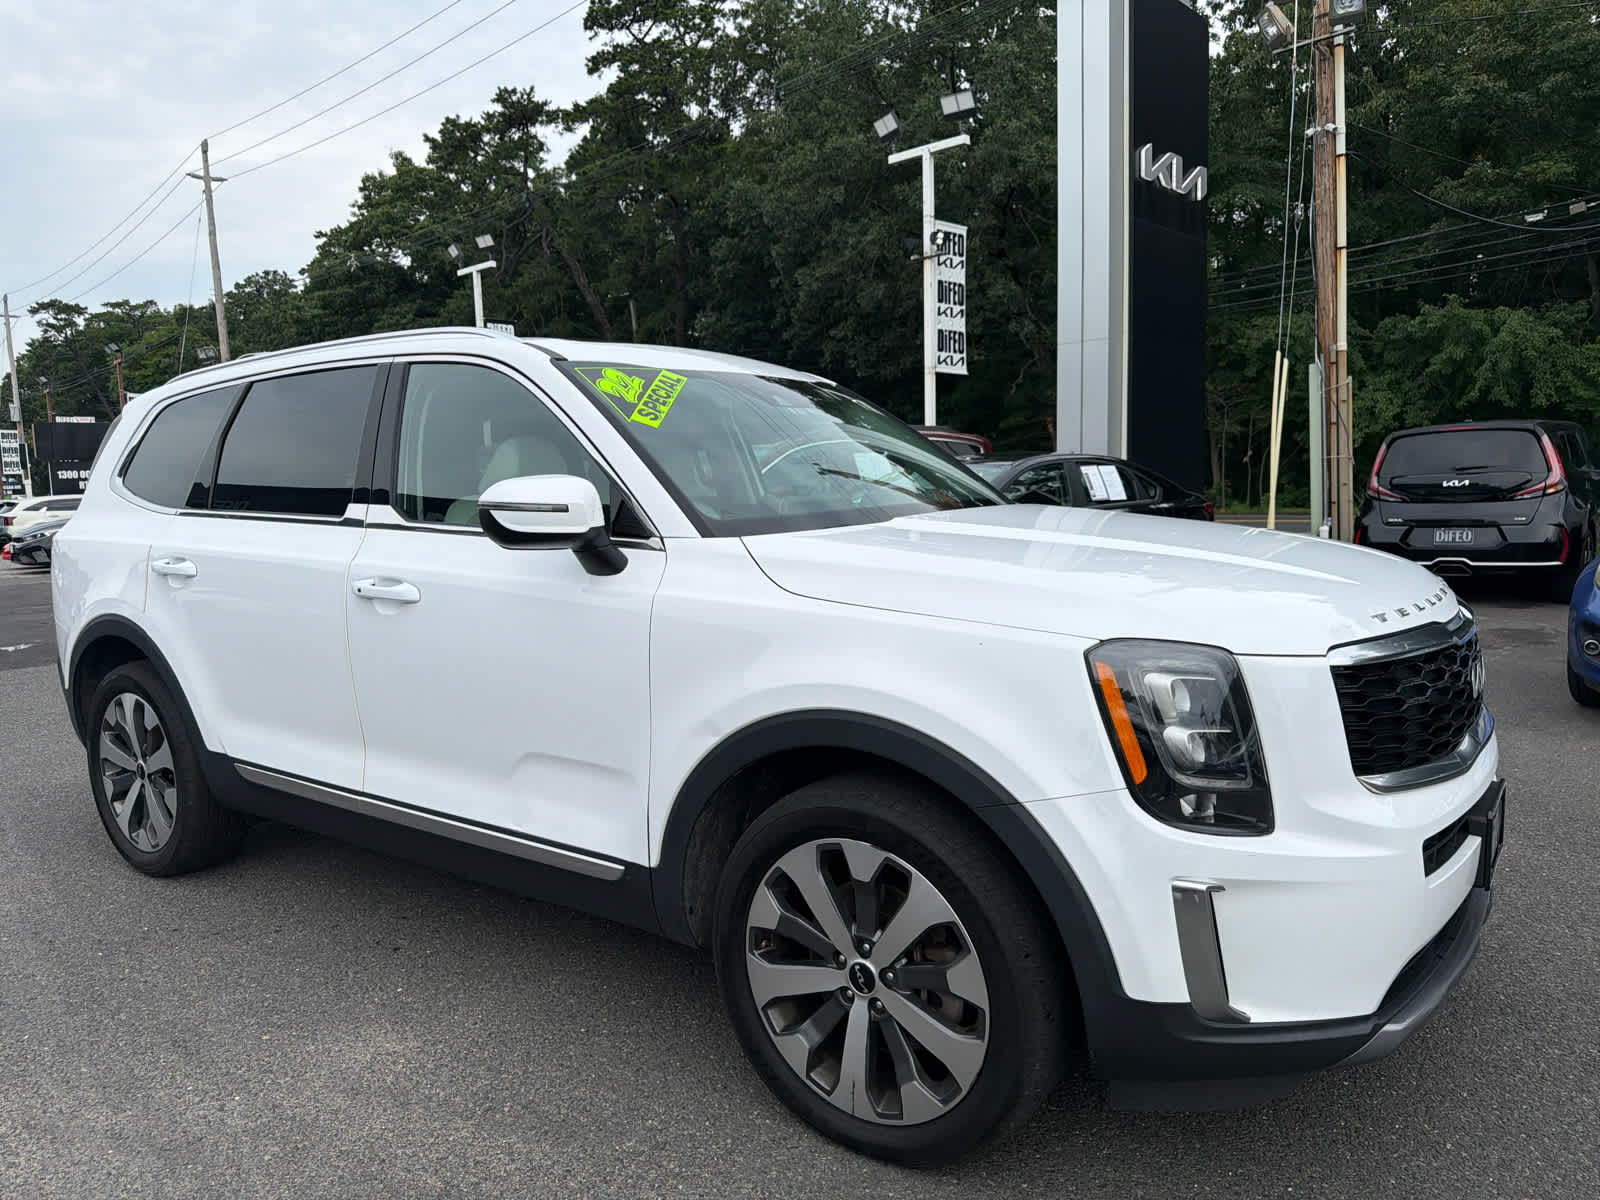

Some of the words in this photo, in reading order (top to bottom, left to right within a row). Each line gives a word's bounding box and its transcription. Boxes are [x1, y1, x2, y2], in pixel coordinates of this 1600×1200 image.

[1139, 142, 1208, 200] KIA
[937, 256, 964, 269] KIA
[937, 306, 964, 319] KIA
[937, 355, 964, 367] KIA
[637, 374, 682, 422] SPECIAL
[57, 470, 79, 479] 1300
[1442, 479, 1470, 488] KIA
